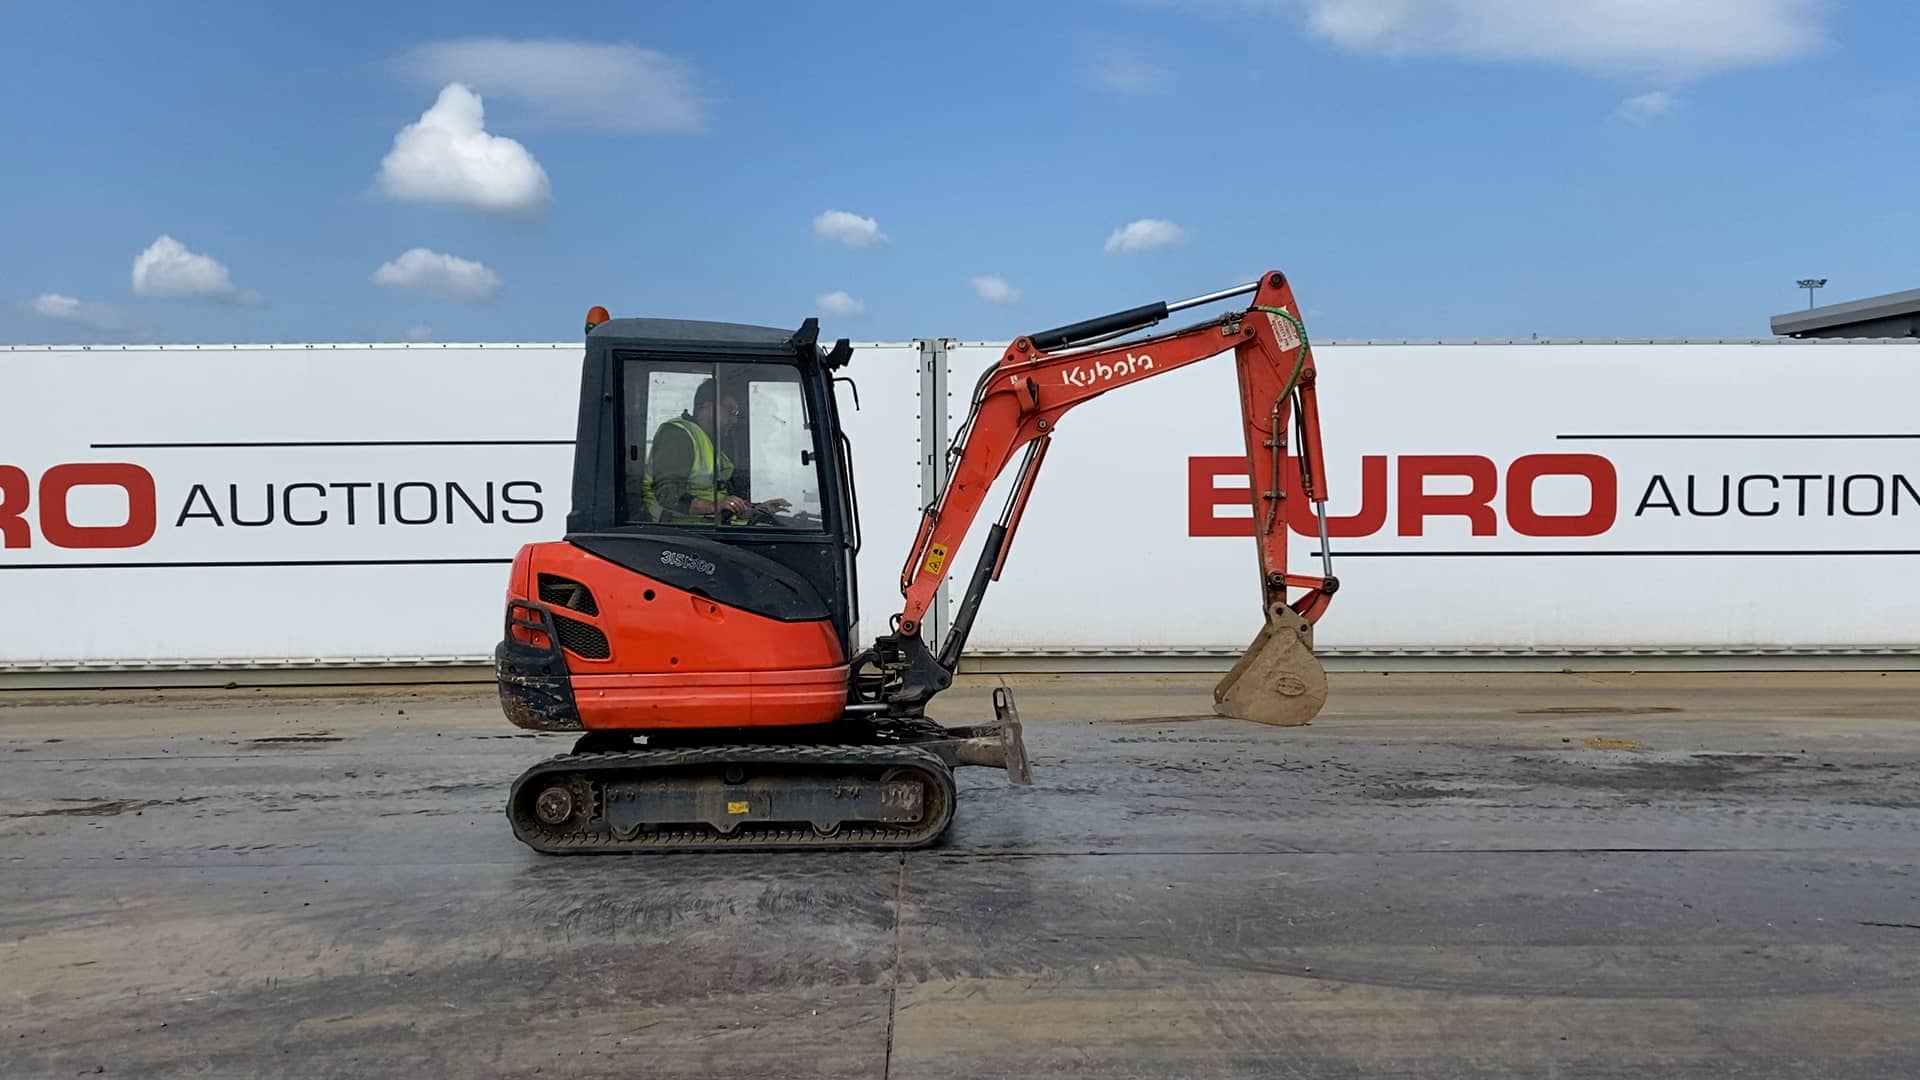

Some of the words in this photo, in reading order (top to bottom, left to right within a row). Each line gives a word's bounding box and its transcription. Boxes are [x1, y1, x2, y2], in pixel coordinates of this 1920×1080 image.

[1062, 353, 1154, 387] Kubota
[176, 480, 544, 528] AUCTIONS
[1188, 453, 1617, 538] EURO
